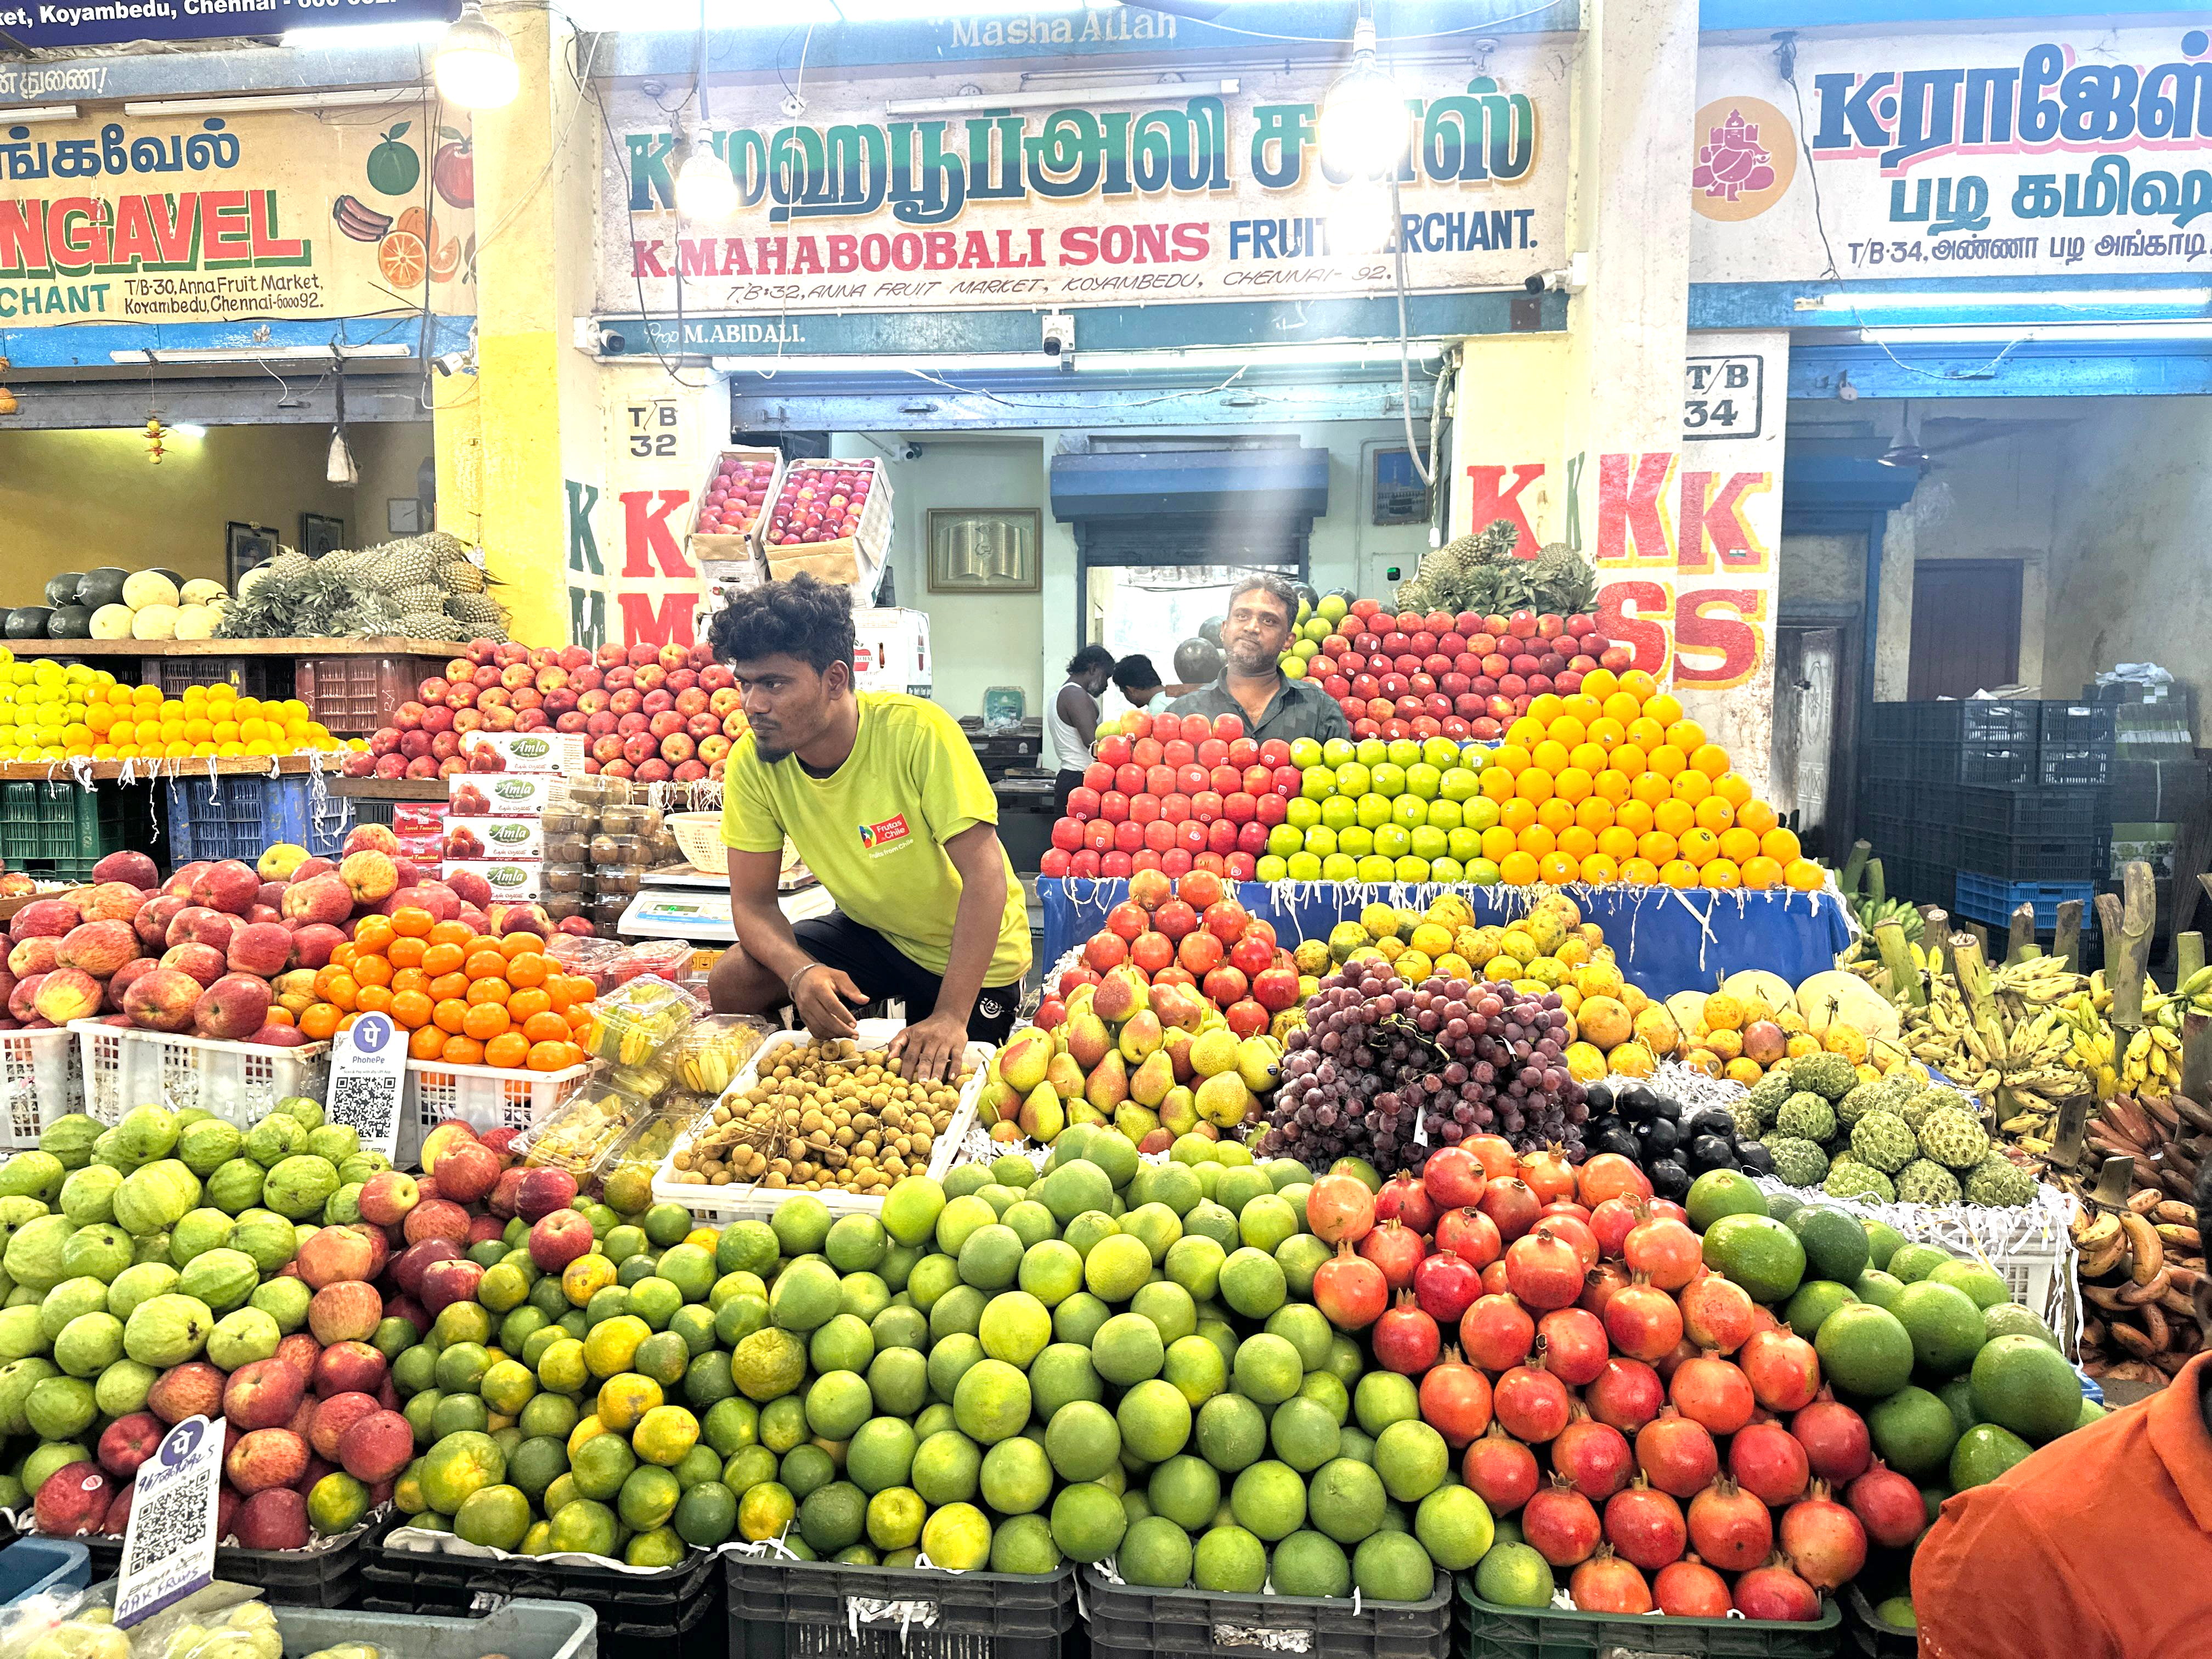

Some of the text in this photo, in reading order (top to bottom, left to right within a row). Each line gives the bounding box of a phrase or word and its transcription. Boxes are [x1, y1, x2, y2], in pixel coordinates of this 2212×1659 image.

[40, 2, 177, 26] Koyambedu,
[950, 14, 1073, 48] Masha
[1059, 222, 1210, 267] SONS
[219, 276, 257, 293] Fruit
[261, 274, 324, 291] Market,
[873, 280, 941, 296] FRUIT
[949, 278, 1049, 294] MARKET,
[1061, 273, 1204, 291] KOYAMBEDU,
[684, 324, 806, 344] M.ABIDALI.
[1686, 359, 1750, 395] T/B
[1683, 400, 1739, 427] 34
[630, 434, 677, 457] 32
[1466, 464, 1545, 561] K
[1598, 452, 1677, 558] K
[565, 479, 604, 576] K
[1678, 471, 1765, 567] K
[619, 489, 696, 578] K
[618, 593, 699, 650] M
[1673, 589, 1758, 683] S
[510, 741, 546, 753] Amla
[495, 782, 532, 794] Amla
[489, 826, 527, 838] Amla
[877, 820, 902, 833] Frutas
[885, 827, 905, 839] Chile
[884, 845, 899, 855] from
[899, 838, 914, 849] Chile
[487, 868, 524, 882] Amla
